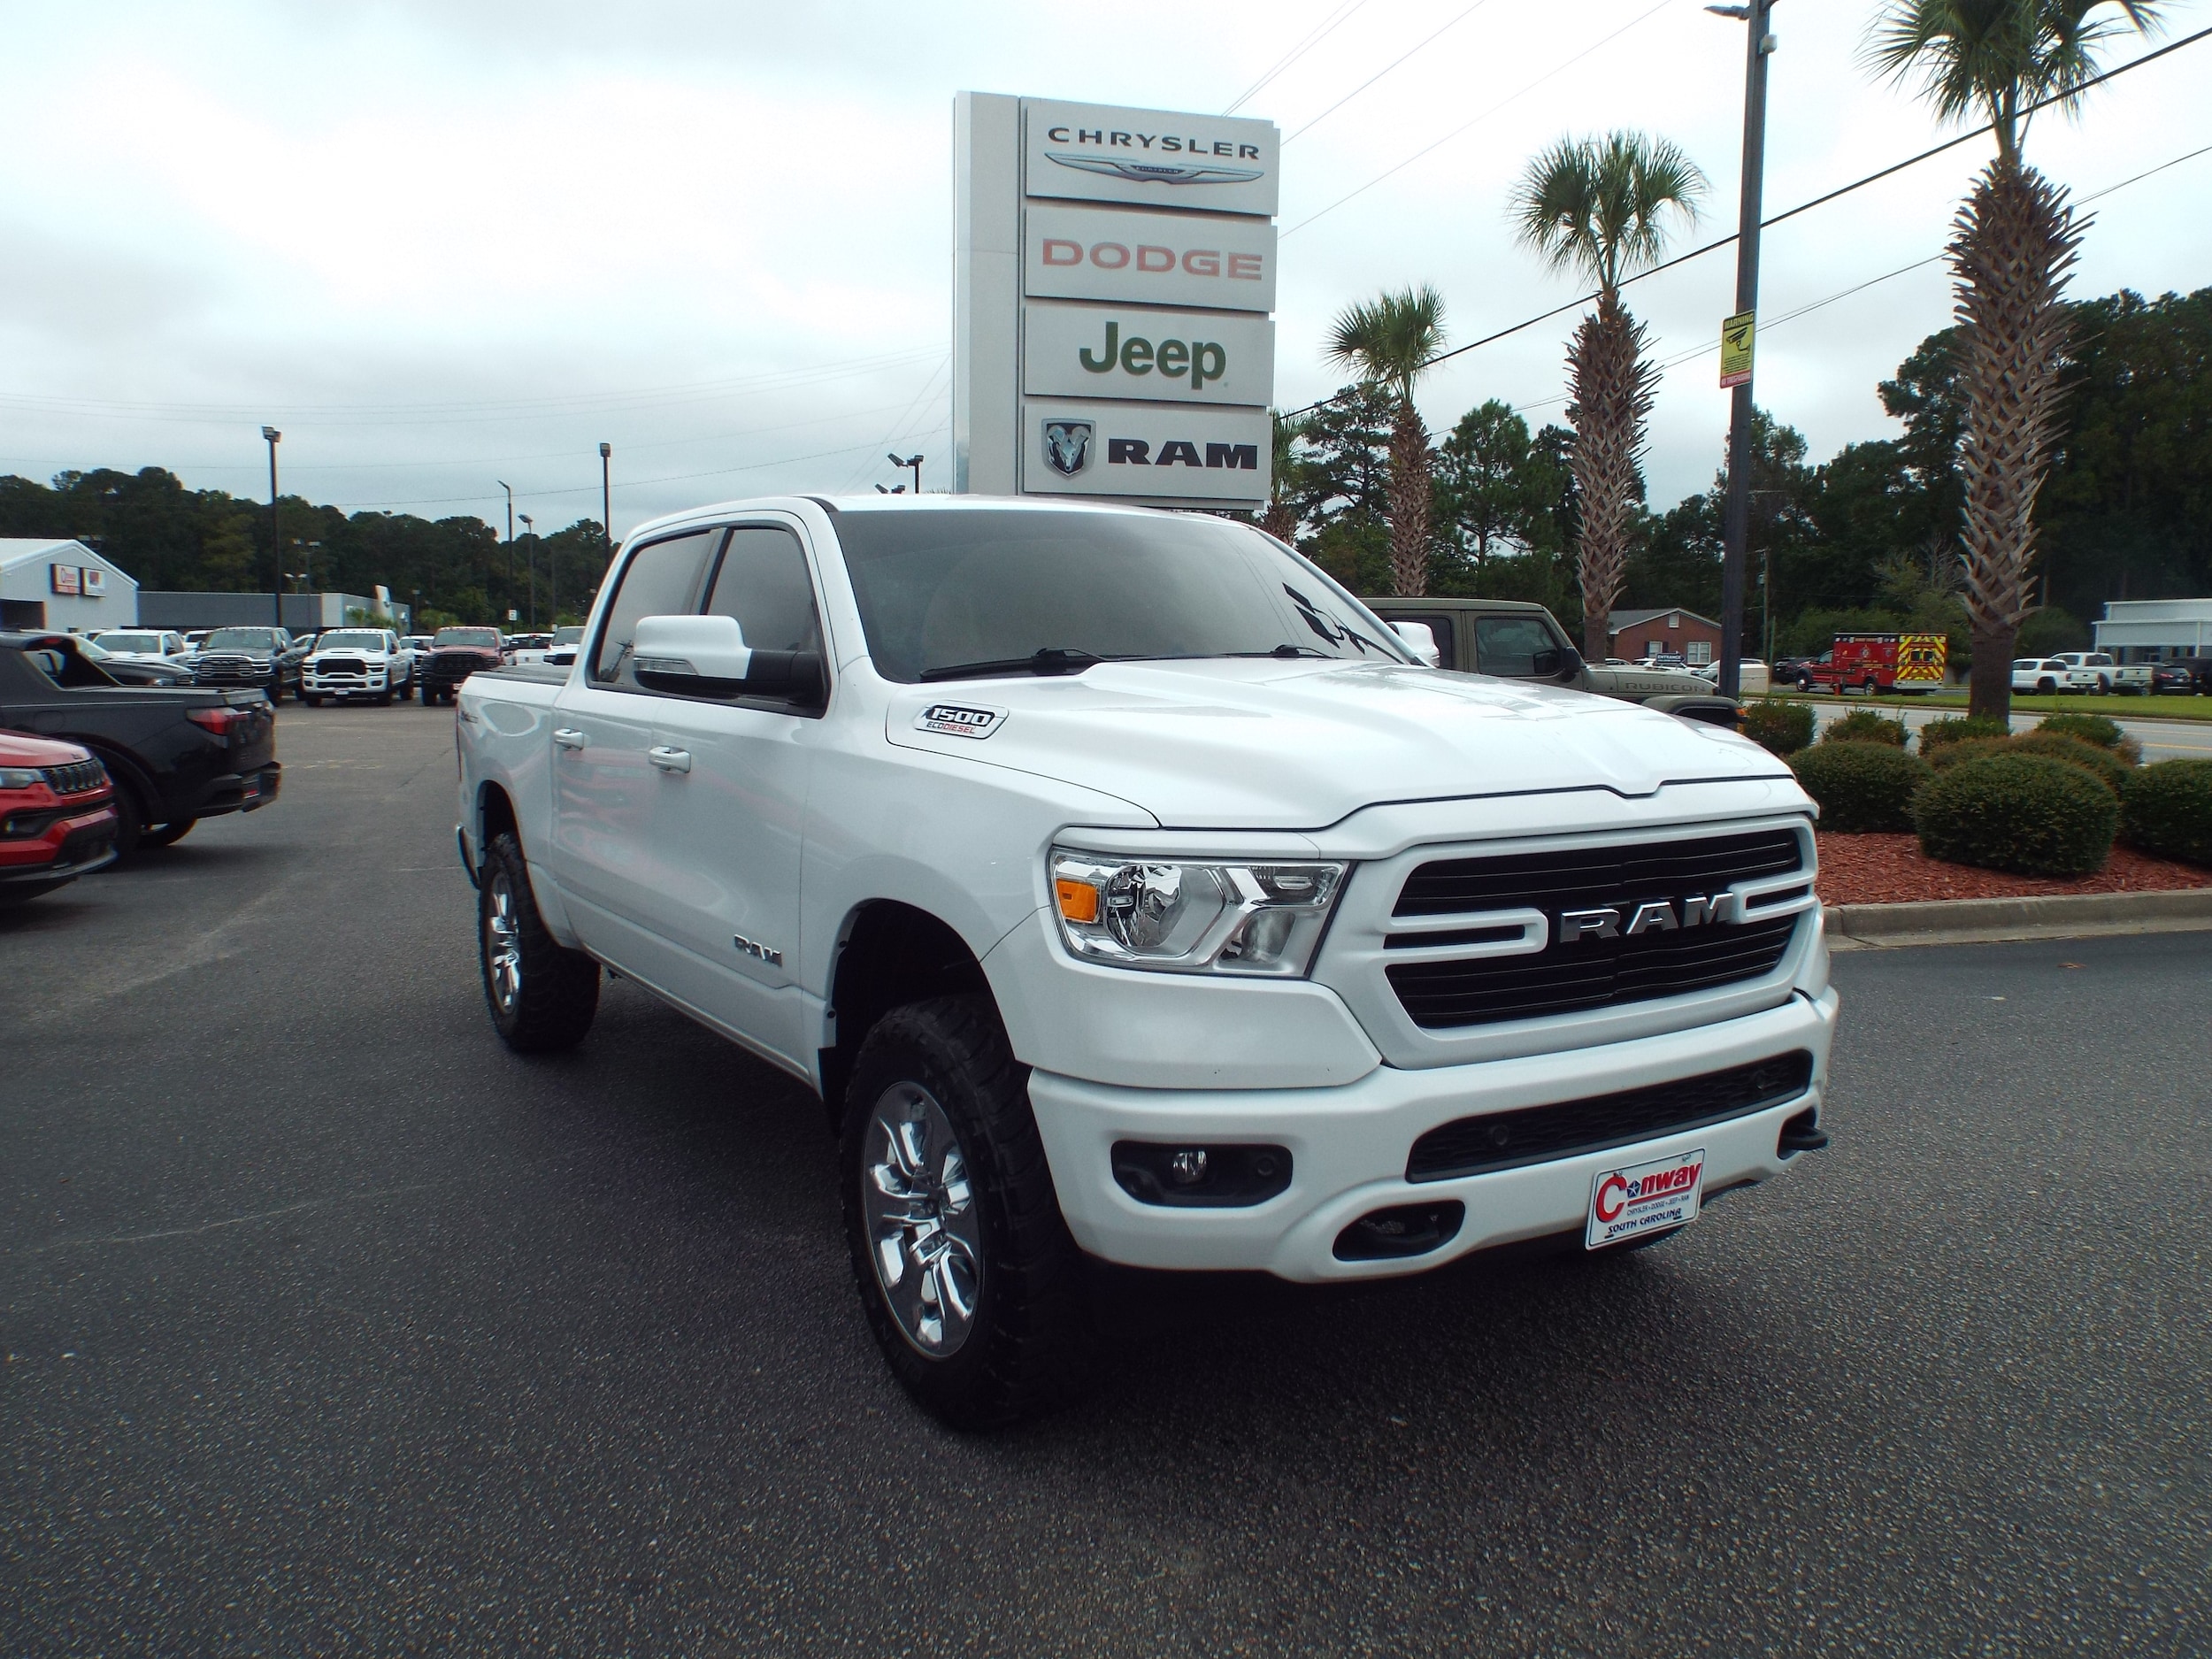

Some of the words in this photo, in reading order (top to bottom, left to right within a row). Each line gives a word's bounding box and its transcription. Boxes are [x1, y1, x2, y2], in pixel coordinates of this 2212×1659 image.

[1048, 127, 1260, 160] CHRYSLER
[1042, 238, 1263, 280] DODGE
[1724, 313, 1754, 330] WARNING
[1079, 321, 1226, 390] Jeep
[1108, 438, 1257, 470] RAM
[1625, 682, 1705, 692] RUBICON
[926, 721, 975, 733] ECODIESEL
[931, 708, 991, 726] 1500
[1560, 892, 1734, 943] RAM
[733, 933, 783, 967] RAM
[1595, 1163, 1702, 1223] Conway
[1608, 1219, 1637, 1234] SOUTH
[1640, 1207, 1681, 1225] CAROLINA
